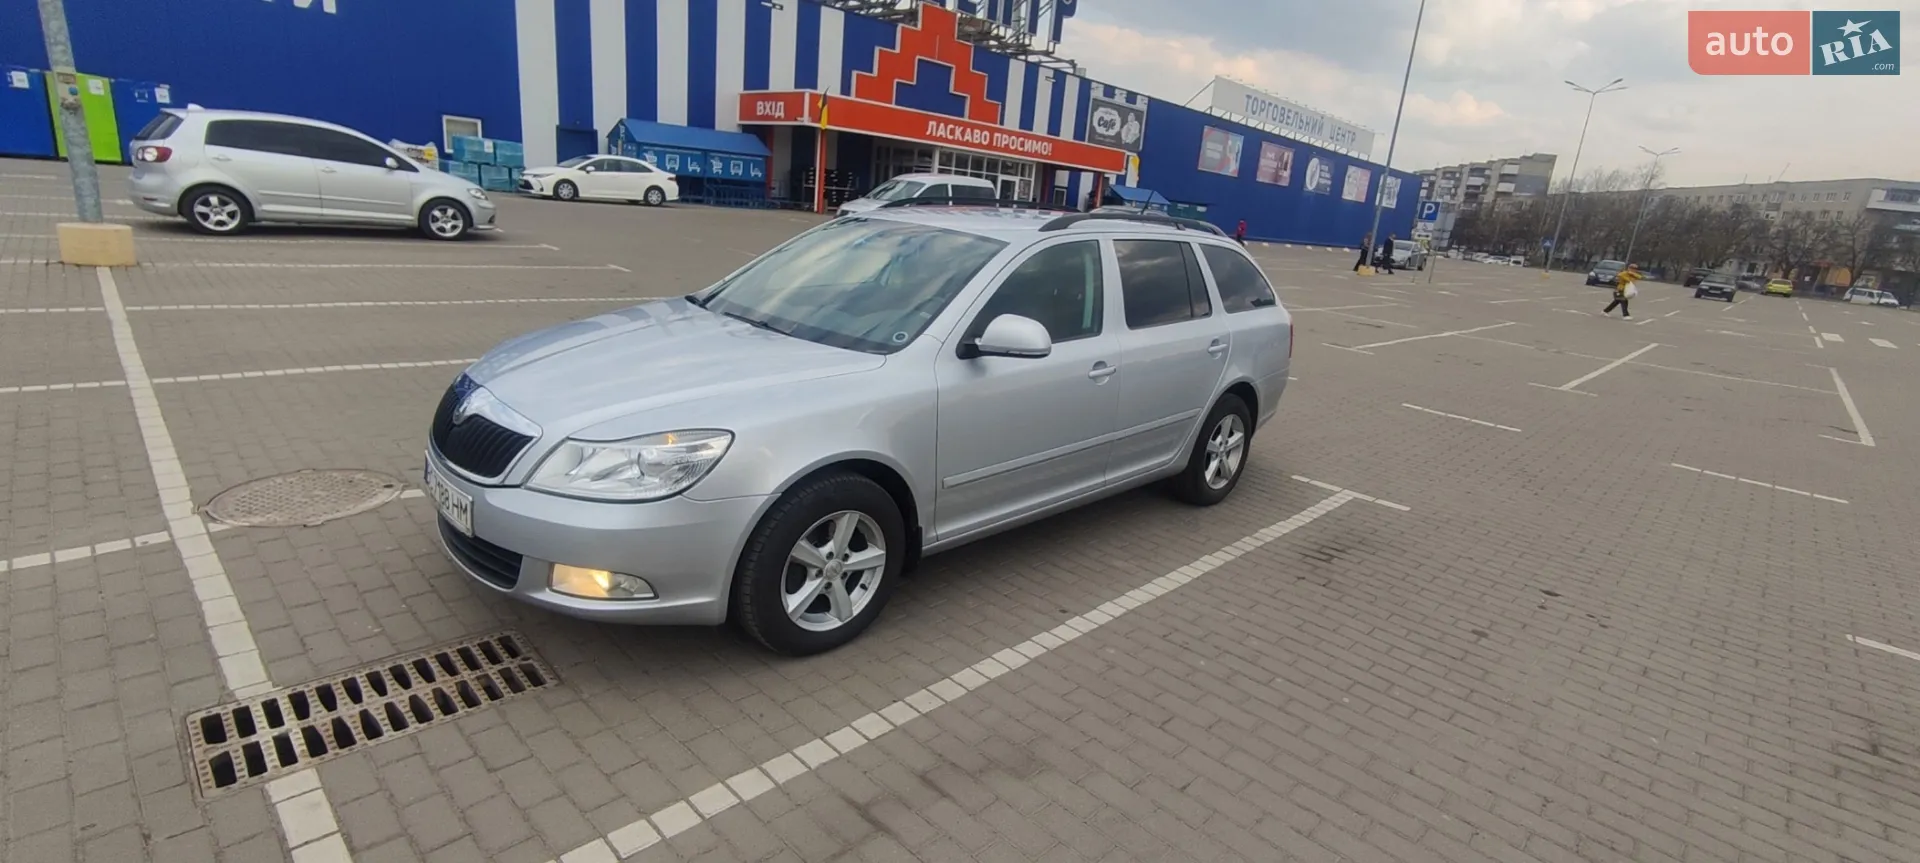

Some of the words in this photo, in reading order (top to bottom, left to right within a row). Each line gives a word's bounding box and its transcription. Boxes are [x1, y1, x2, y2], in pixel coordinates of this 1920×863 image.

[756, 101, 785, 119] ВХІД
[1245, 94, 1324, 136] ТОРГОВЕЛЬНИЙ
[1328, 122, 1357, 145] ЦЕНТР
[925, 120, 989, 144] ЛАСКАВО
[992, 132, 1053, 156] ПРОСИМО!
[1422, 203, 1435, 218] P
